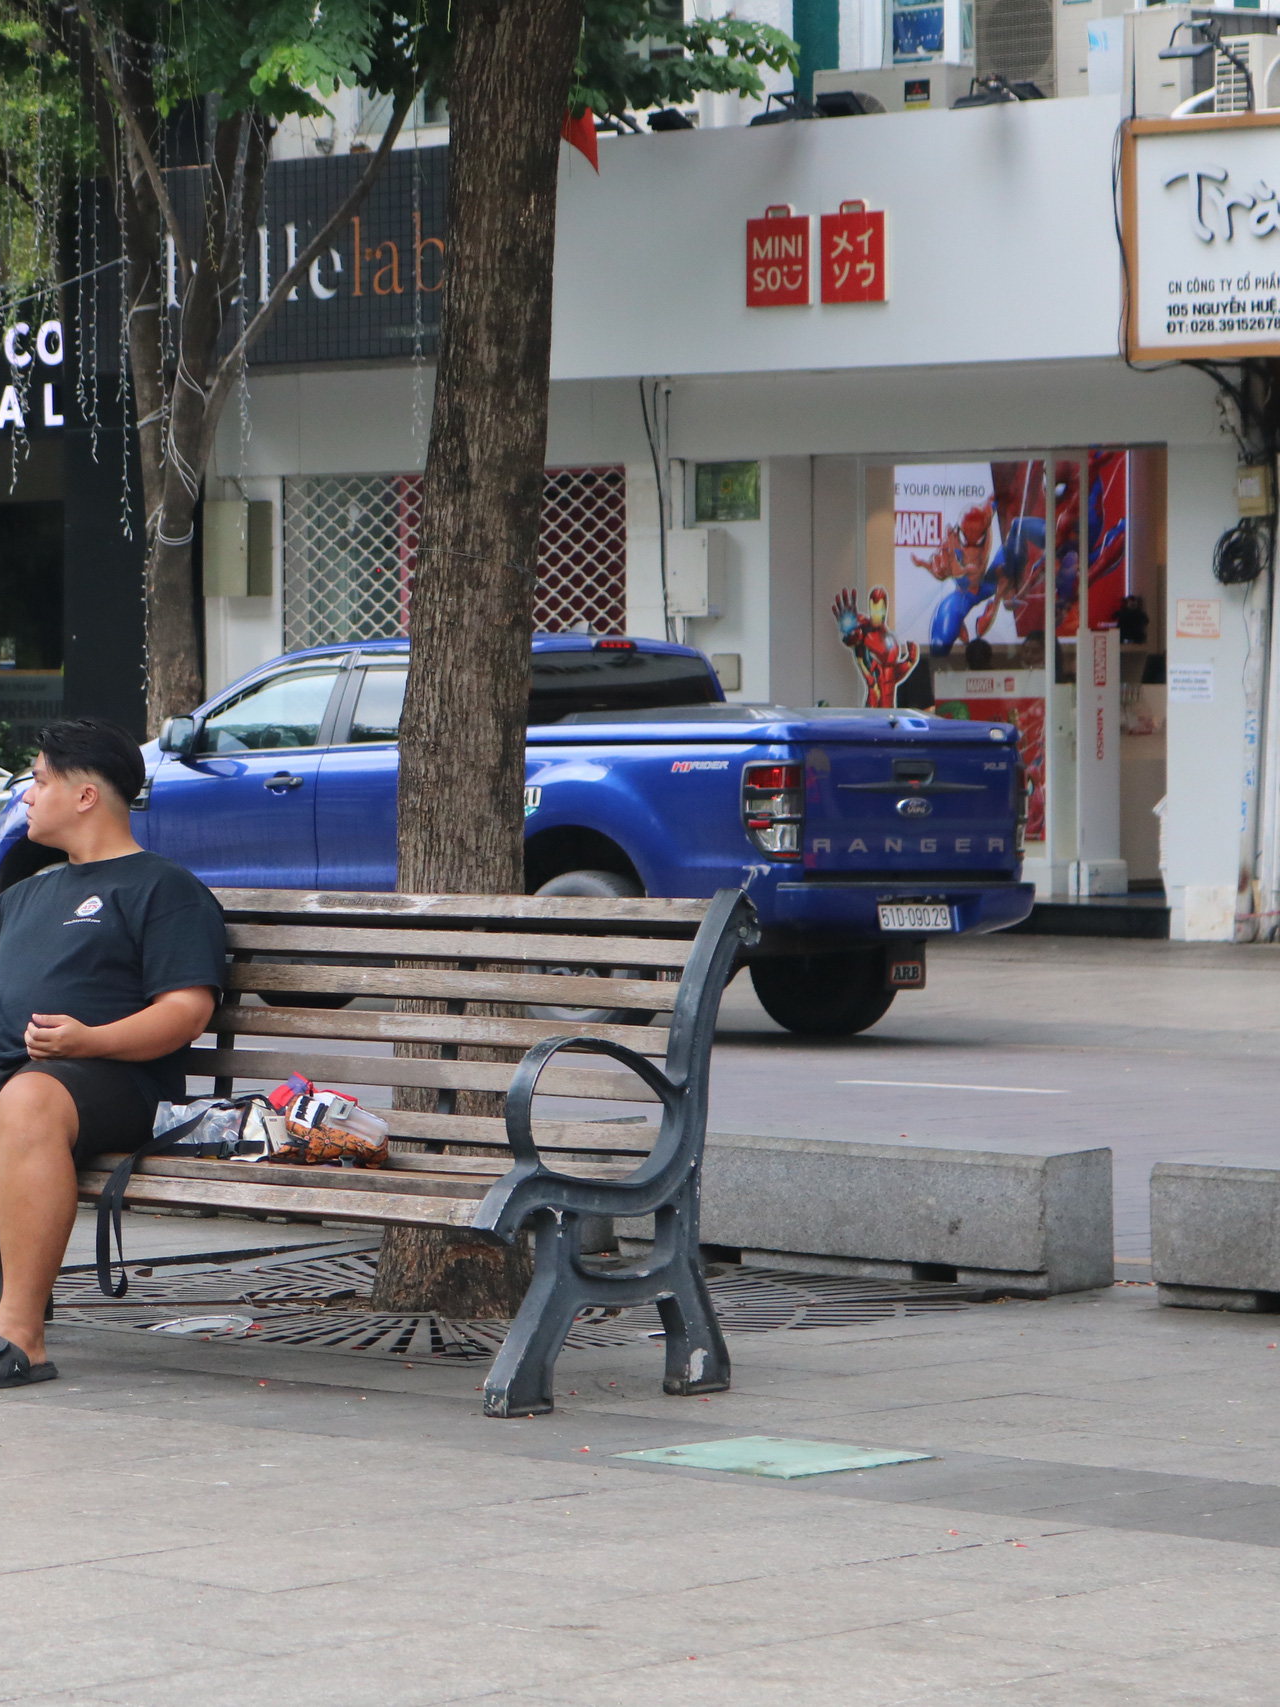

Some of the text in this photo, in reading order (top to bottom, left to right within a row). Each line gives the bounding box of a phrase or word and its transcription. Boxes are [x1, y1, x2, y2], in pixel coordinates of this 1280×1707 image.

[753, 234, 803, 260] MINI
[1168, 279, 1182, 293] CN
[1186, 276, 1215, 293] CÔNG
[1220, 278, 1233, 291] TY
[1166, 303, 1188, 316] 105
[904, 483, 930, 495] YOUR
[933, 484, 956, 496] OWN
[958, 485, 986, 497] HERO
[813, 838, 1005, 853] RANGER
[893, 965, 920, 981] ARB
